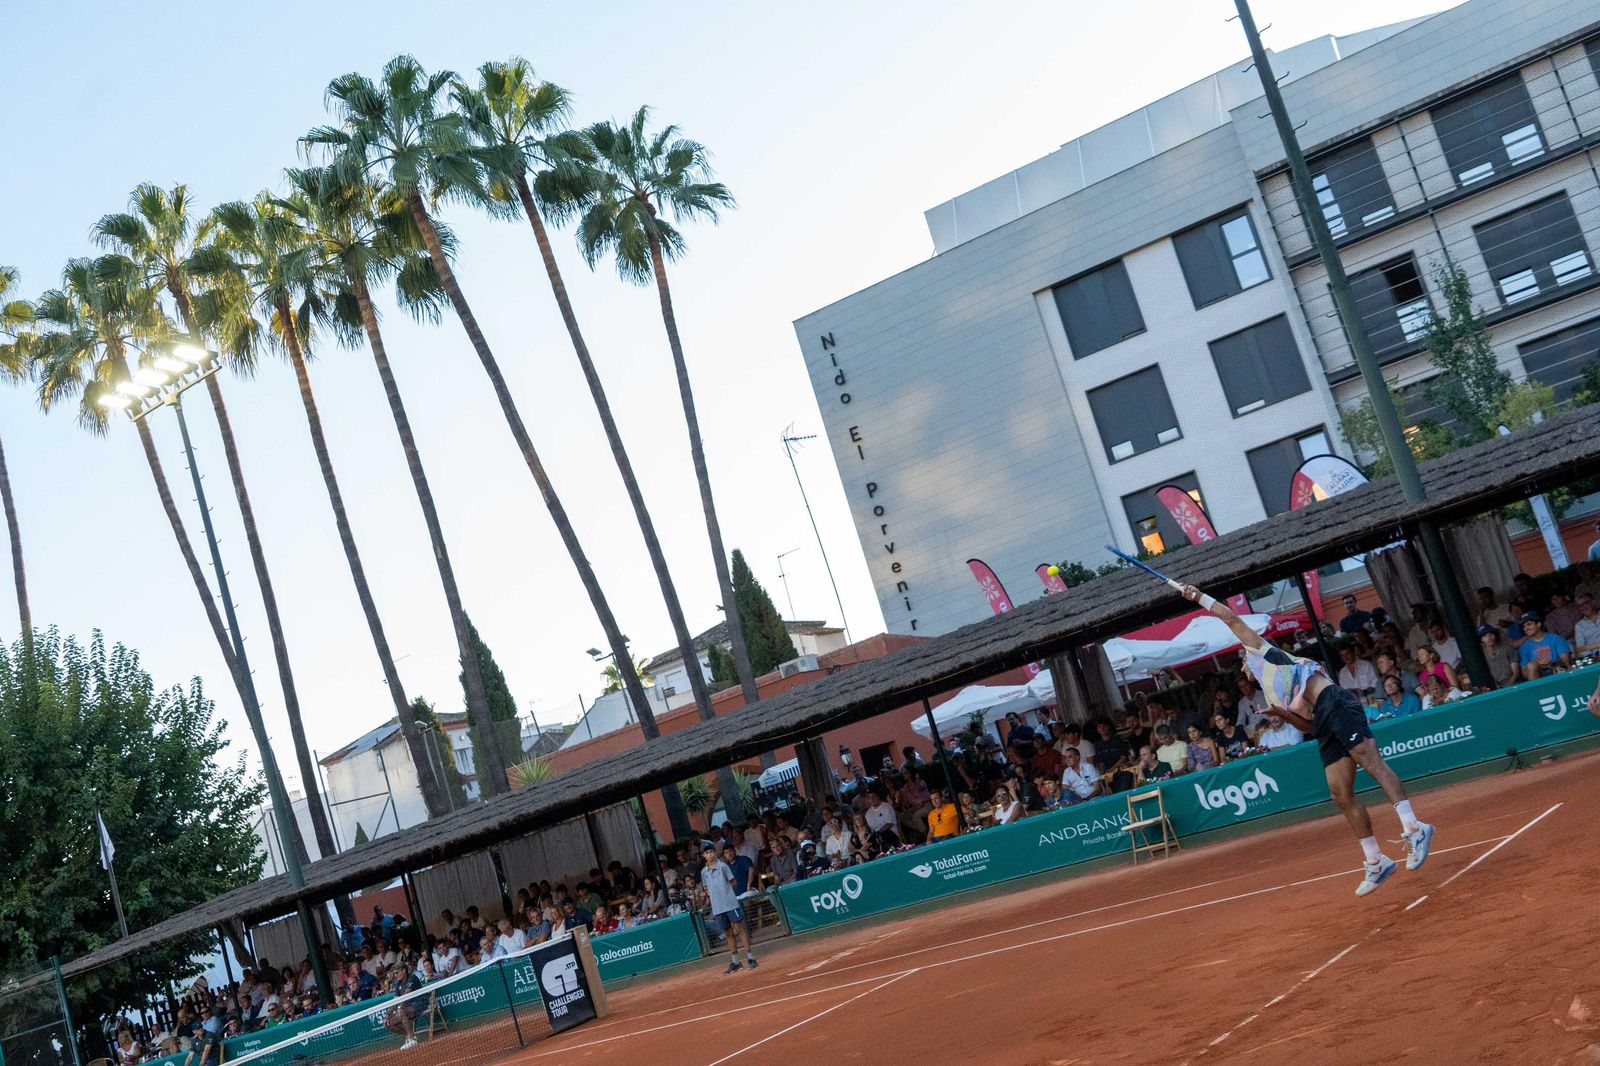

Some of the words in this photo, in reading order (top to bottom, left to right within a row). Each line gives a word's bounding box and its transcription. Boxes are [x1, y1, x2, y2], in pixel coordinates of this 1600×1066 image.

[821, 332, 851, 404] Nido
[849, 425, 864, 460] El
[866, 482, 917, 631] Porvenir
[1038, 811, 1133, 846] ANDBANK
[1082, 834, 1105, 847] Private
[932, 850, 989, 870] TotalFarma
[943, 865, 986, 880] total-farma.com
[810, 888, 847, 913] FOX
[835, 906, 850, 915] ESS
[600, 940, 653, 962] solocanarias
[548, 989, 586, 1010] CHALLENGER
[551, 1005, 569, 1019] TOUR
